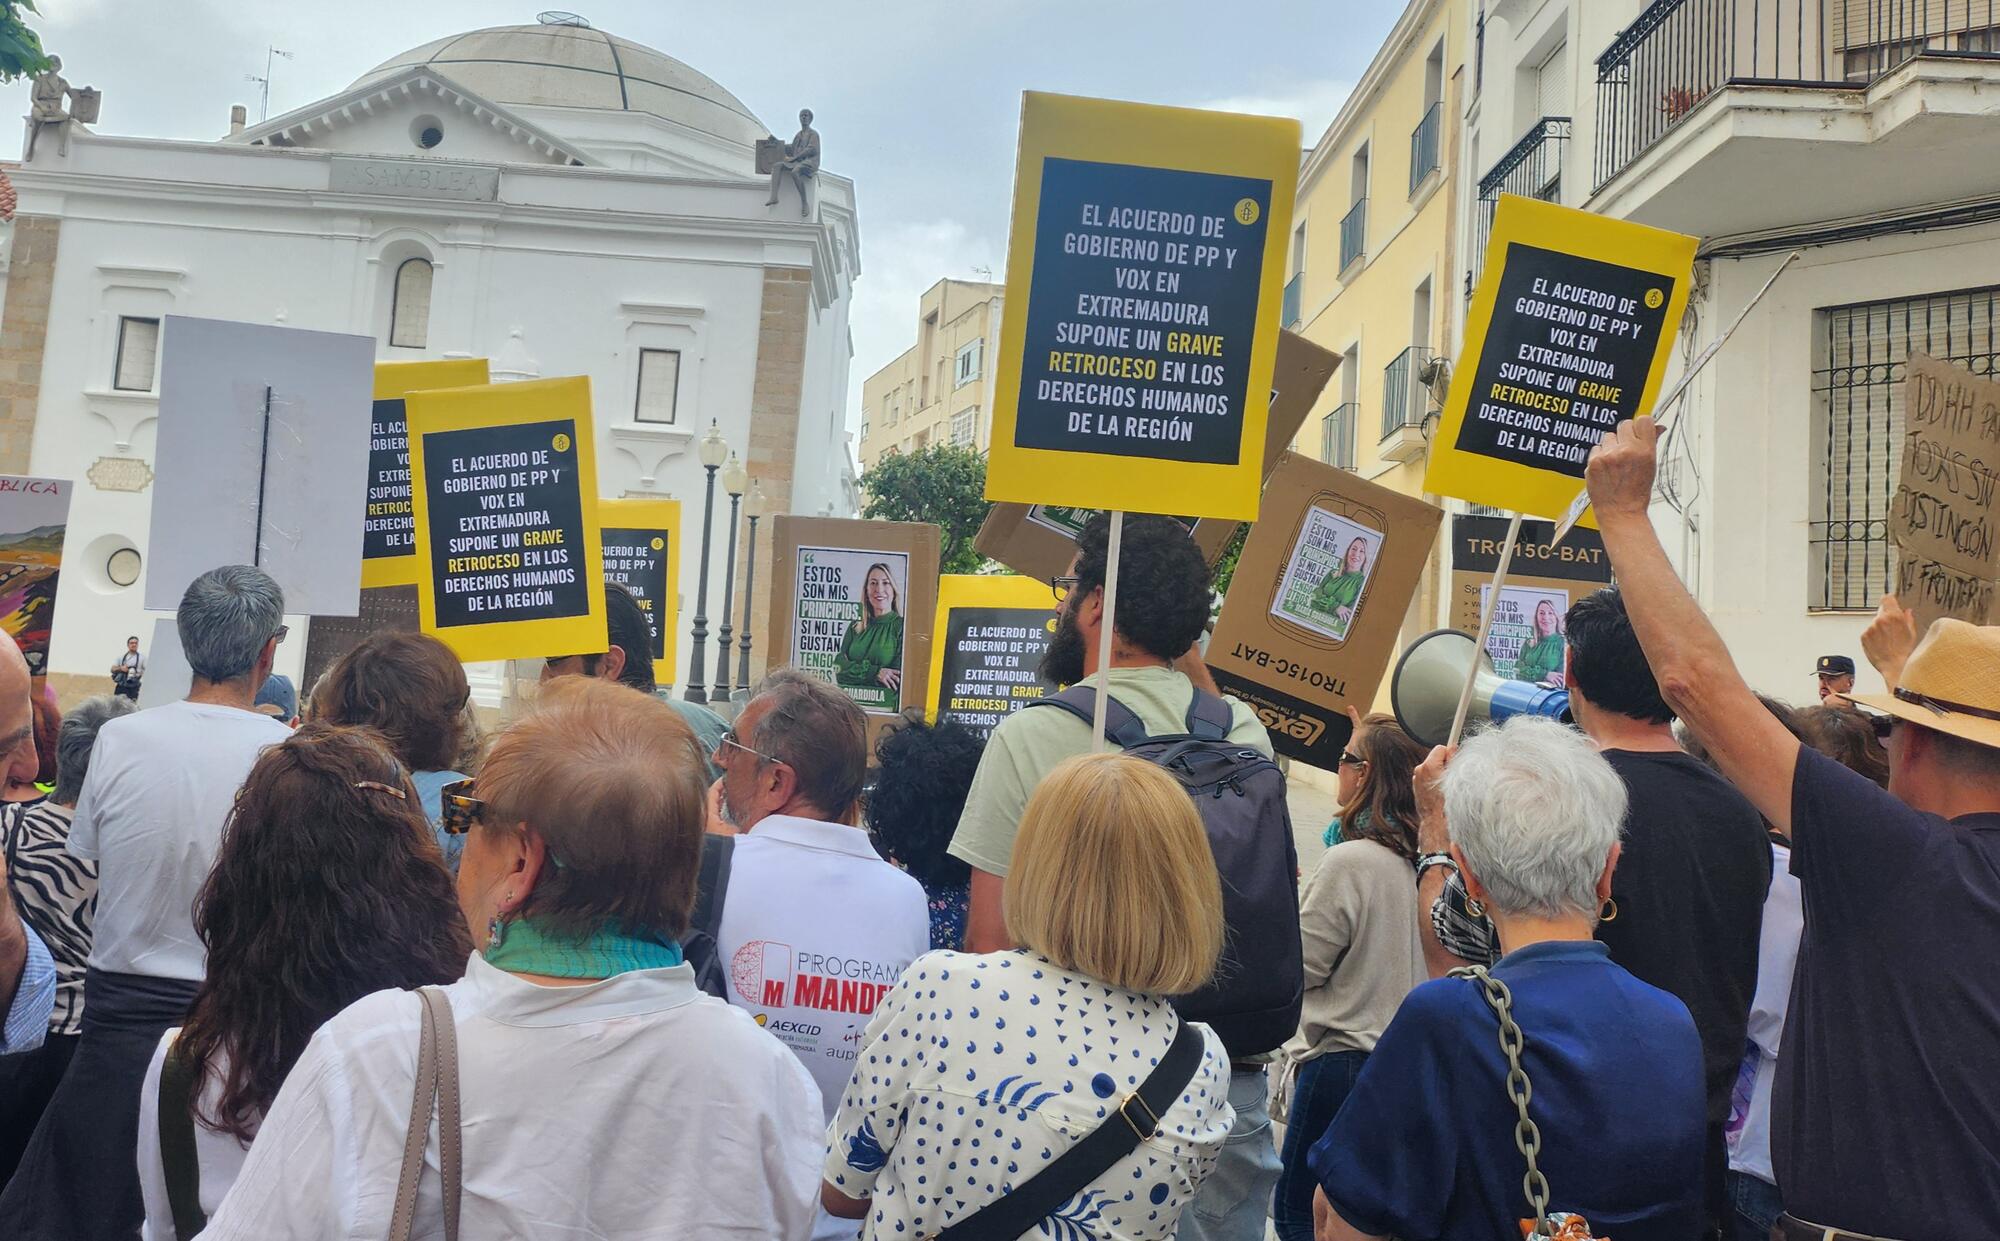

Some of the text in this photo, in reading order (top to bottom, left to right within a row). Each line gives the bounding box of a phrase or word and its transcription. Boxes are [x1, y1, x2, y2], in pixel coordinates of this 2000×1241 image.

[1082, 204, 1225, 238] EL ACUERDO DE
[1064, 233, 1237, 268] GOBIERNO DE PP Y
[1116, 268, 1180, 294] VOX EN
[1532, 278, 1637, 316] EL ACUERDO DE
[1077, 294, 1208, 326] EXTREMADURA
[1515, 298, 1642, 339] GOBIERNO DE PP Y
[1056, 322, 1224, 357] SUPONE UN GRAVE
[1550, 328, 1598, 352] VOX EN
[1049, 352, 1224, 386] RETROCESO EN LOS
[1518, 344, 1614, 379] EXTREMADURA
[1499, 362, 1621, 404] SUPONE UN GRAVE
[1038, 380, 1228, 415] DERECHOS HUMANOS
[1491, 384, 1618, 425] RETROCESO EN LOS
[1913, 371, 1975, 436] DDHH
[373, 423, 385, 434] EL
[1068, 412, 1193, 442] DE LA REGIÓN
[1479, 403, 1607, 445] DERECHOS HUMAN
[1498, 430, 1515, 448] DE
[1519, 435, 1534, 452] LA
[452, 450, 549, 472] EL ACUERDO DE
[370, 485, 412, 499] SUPONE
[444, 469, 560, 493] GOBIERNO DE PP Y
[480, 493, 524, 510] VOX EN
[460, 511, 550, 531] EXTREMADURA
[386, 533, 415, 546] DE LA
[450, 529, 563, 552] SUPONE UN GRAVE
[1310, 523, 1337, 542] ESTOS
[448, 549, 568, 573] RETROCESO EN LOS
[636, 547, 648, 556] DE
[620, 560, 631, 569] DE
[634, 560, 646, 569] PP
[649, 560, 655, 570] Y
[804, 566, 841, 583] ESTOS
[445, 569, 575, 593] DERECHOS HUMANOS
[617, 573, 628, 583] EN
[468, 588, 553, 611] DE LA REGIÓN
[803, 583, 848, 600] SON MIS
[801, 601, 862, 620] PRINCIPIOS.
[1493, 612, 1524, 624] ON MIS
[801, 620, 843, 636] SI NO LE
[968, 626, 1042, 639] EL ACUERDO DE
[800, 636, 841, 652] GUSTAN
[959, 641, 1049, 653] GOBIERNO DE PP Y
[800, 652, 833, 668] TENGO
[985, 655, 1019, 667] VOX EN
[1231, 642, 1346, 697] TRO15C-BAT
[965, 669, 1035, 682] EXTREMADURA
[954, 684, 1044, 697] SUPONE UN GRAVE
[951, 698, 1007, 711] RETROCESO
[798, 952, 908, 982] PROGRAM
[770, 1020, 822, 1036] AEXCID
